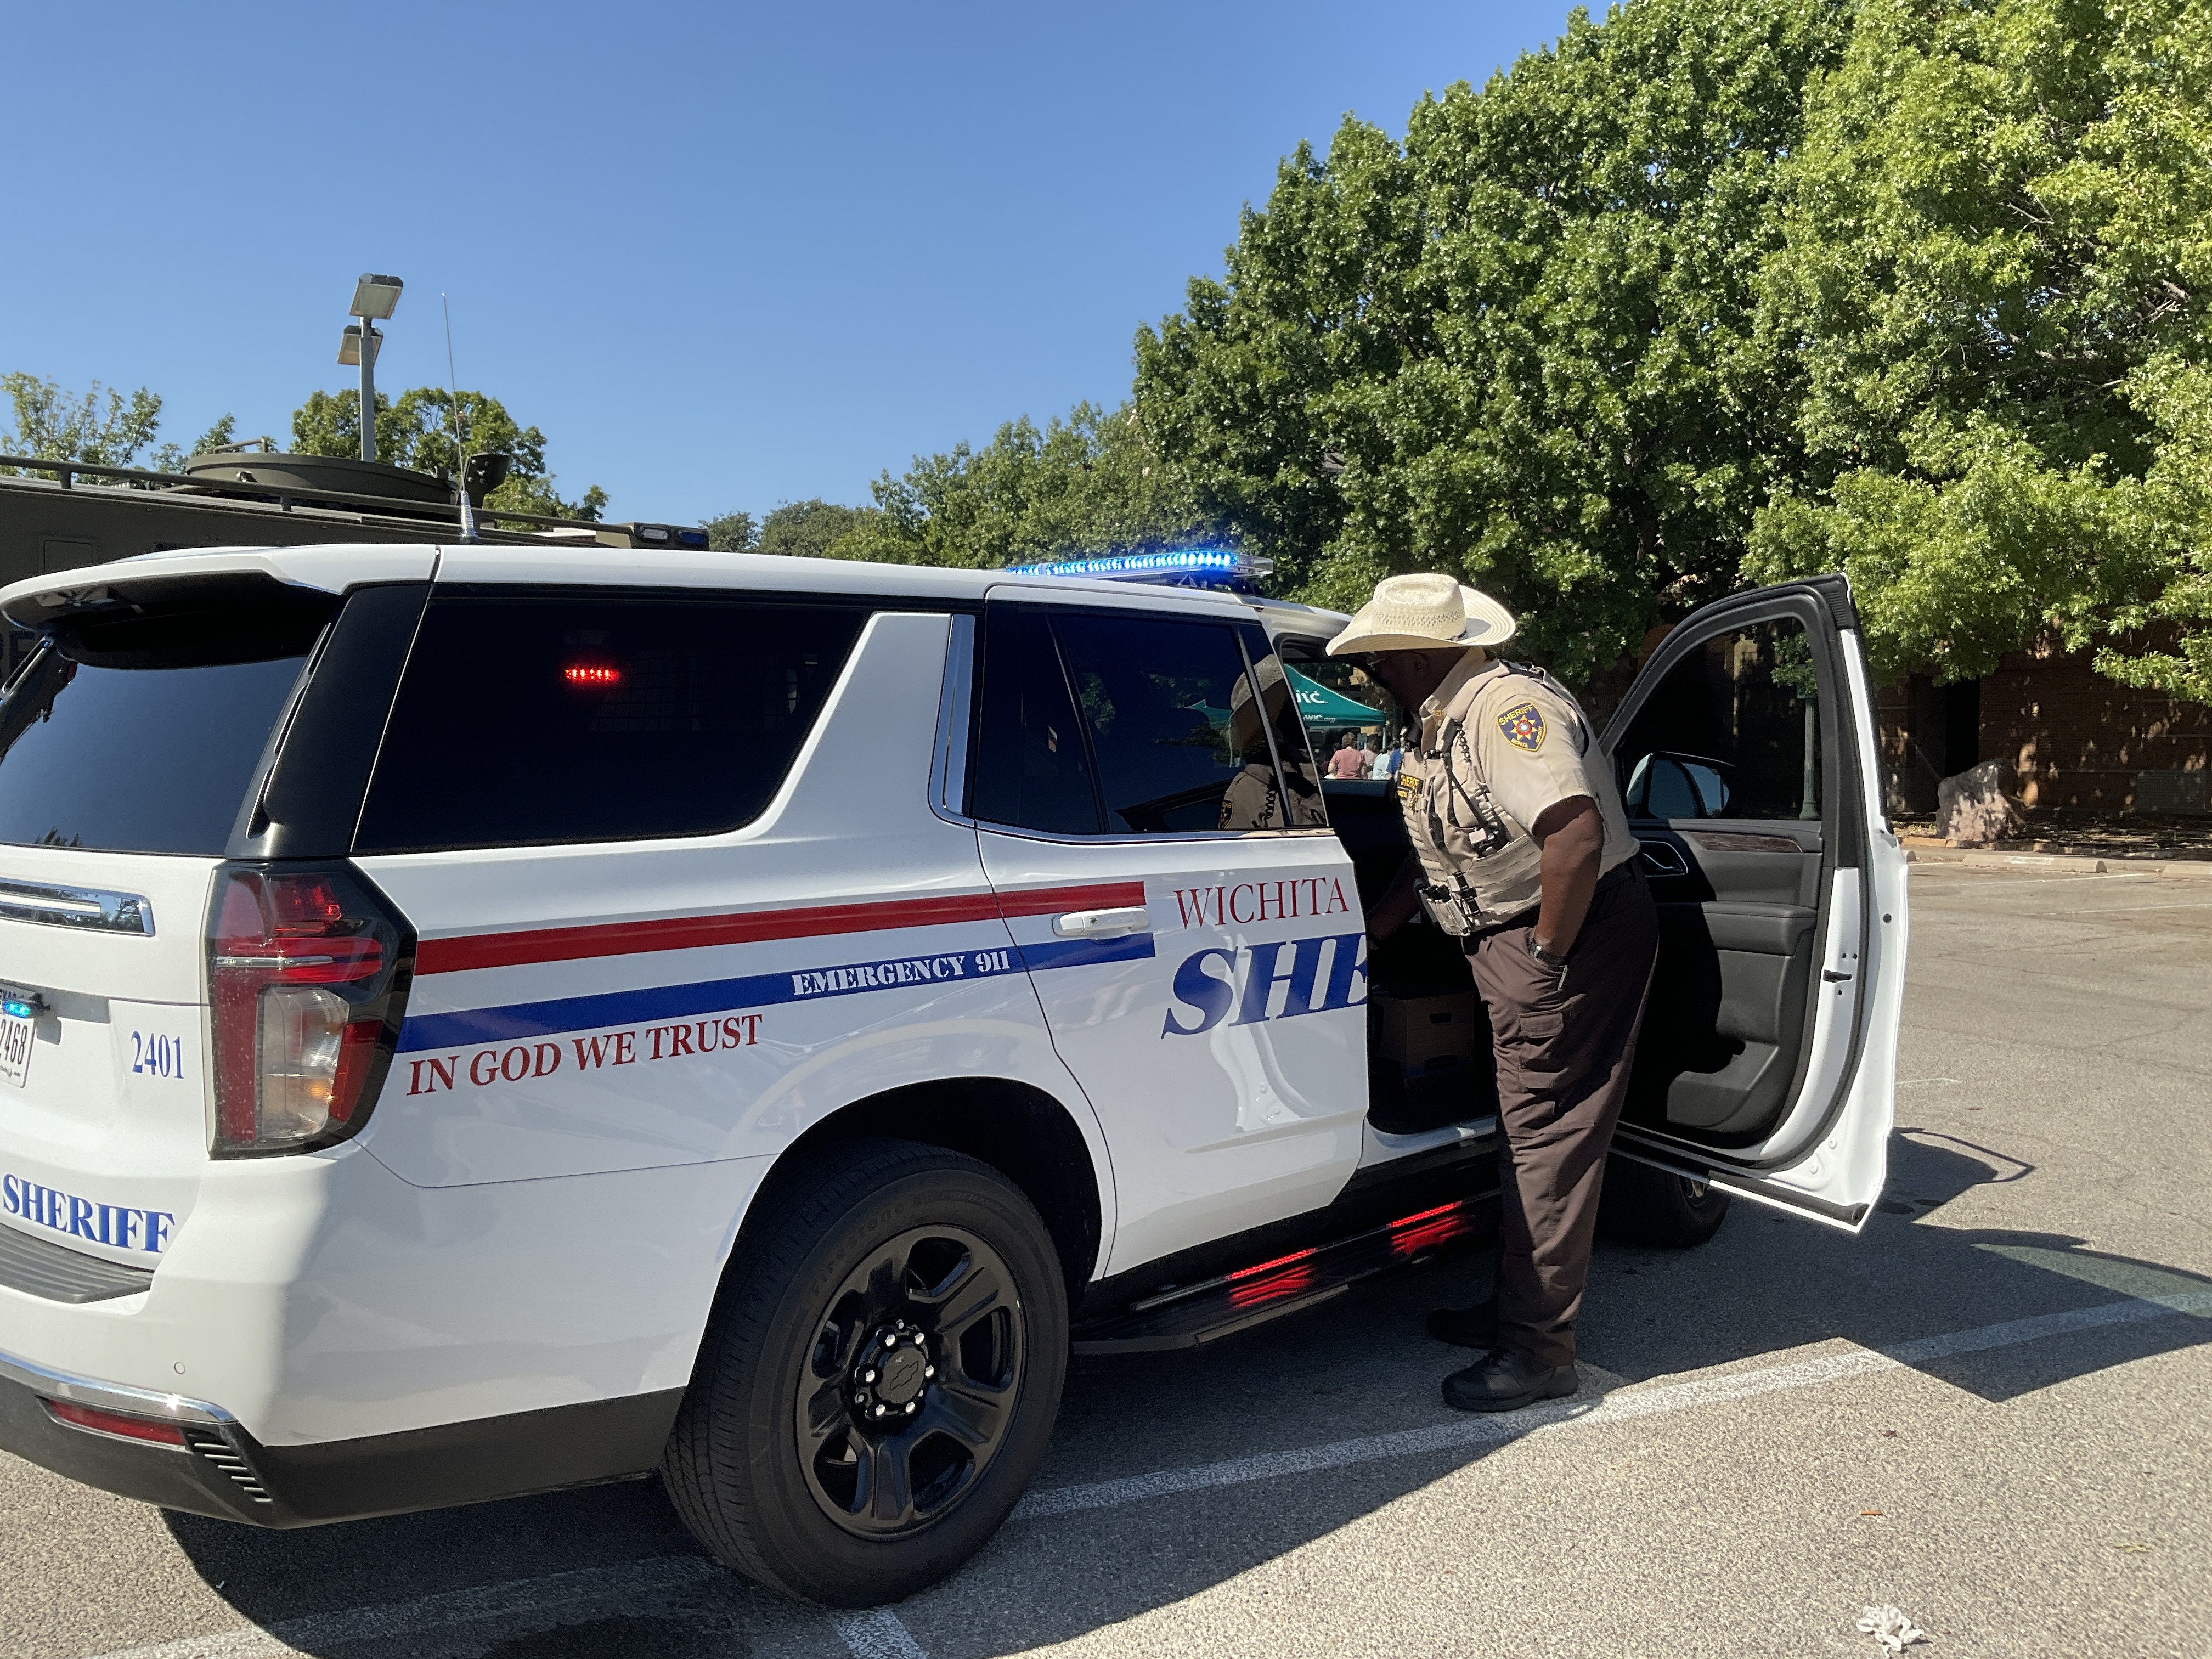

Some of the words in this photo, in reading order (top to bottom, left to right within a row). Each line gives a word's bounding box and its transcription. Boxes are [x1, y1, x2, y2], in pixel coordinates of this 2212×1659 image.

[1499, 704, 1533, 726] SHERIFF
[1173, 878, 1351, 929] WICHITA
[791, 955, 966, 996] EMERGENCY
[975, 950, 1010, 972] 911
[131, 1030, 185, 1080] 2401
[407, 1055, 460, 1096] IN
[469, 1042, 562, 1086] GOD
[572, 1031, 636, 1071] WE
[645, 1014, 763, 1060] TRUST
[2, 1173, 176, 1254] SHERIFF
